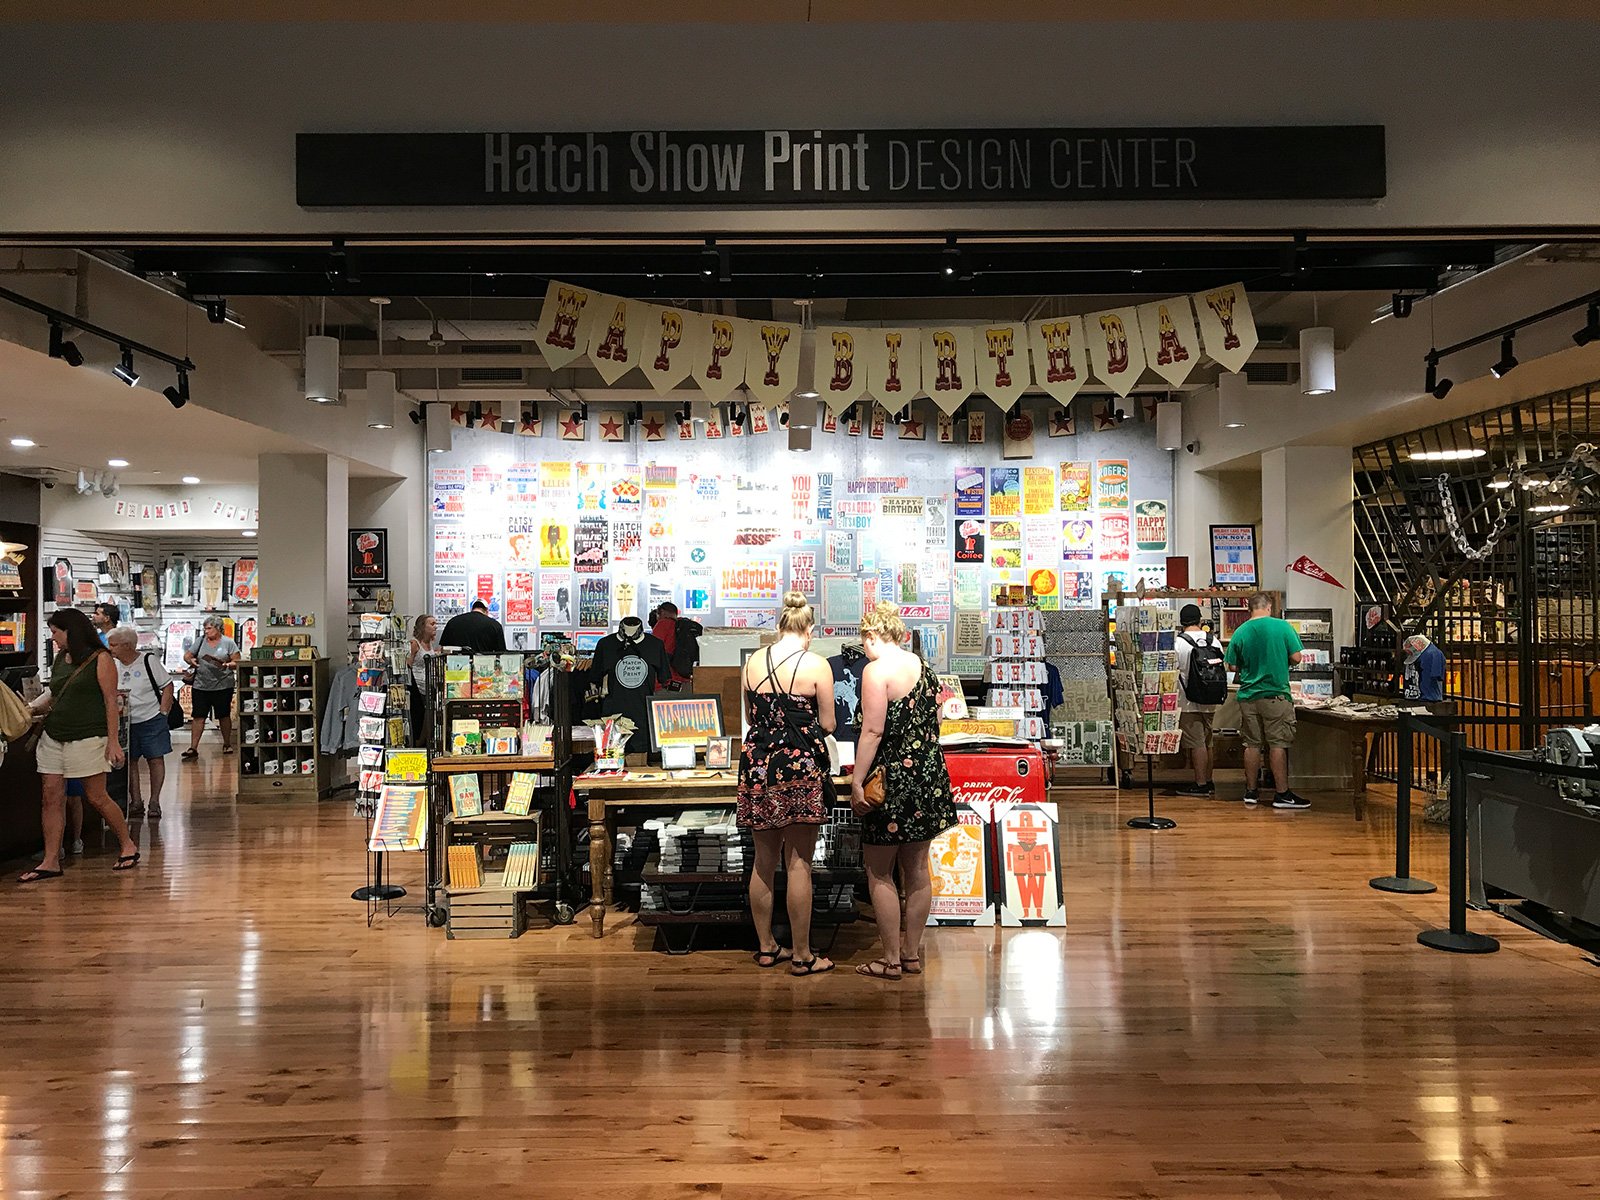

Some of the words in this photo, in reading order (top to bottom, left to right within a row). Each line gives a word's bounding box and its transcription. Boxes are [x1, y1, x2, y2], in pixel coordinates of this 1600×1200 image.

[484, 133, 609, 193] Hatch
[629, 131, 745, 193] Show
[764, 130, 870, 192] Print
[888, 138, 1031, 191] DESIGN
[1049, 137, 1199, 189] CENTER
[544, 287, 791, 388] HAPPY
[829, 289, 1237, 393] BIRTHDAY
[1100, 466, 1127, 476] ROGERS
[791, 475, 811, 491] YOU
[817, 473, 833, 486] YOU
[847, 481, 866, 493] HAPPY
[1100, 483, 1127, 495] SHOWS
[791, 492, 810, 500] DID
[817, 508, 832, 520] ME
[882, 505, 923, 514] BIRTHDAY
[508, 517, 533, 525] PATSY
[613, 522, 642, 530] HATCH
[856, 516, 871, 528] BOY
[1137, 517, 1165, 526] HAPPY
[508, 525, 533, 533] CLINE
[613, 531, 642, 539] SHOW
[613, 539, 642, 547] PRINT
[648, 546, 676, 557] FREE
[957, 551, 983, 559] Coffee
[792, 556, 813, 567] LOVE
[794, 568, 813, 579] YOU
[1216, 564, 1231, 573] DOLLY
[1233, 564, 1253, 573] PARTON
[721, 568, 777, 591] NASHVILLE
[791, 580, 815, 592] MORE
[731, 618, 748, 627] ELVIS
[656, 703, 716, 733] NASHVILLE
[393, 756, 427, 768] NASHVILLE
[950, 786, 1025, 804] Coca-Cola
[958, 814, 981, 825] CATS
